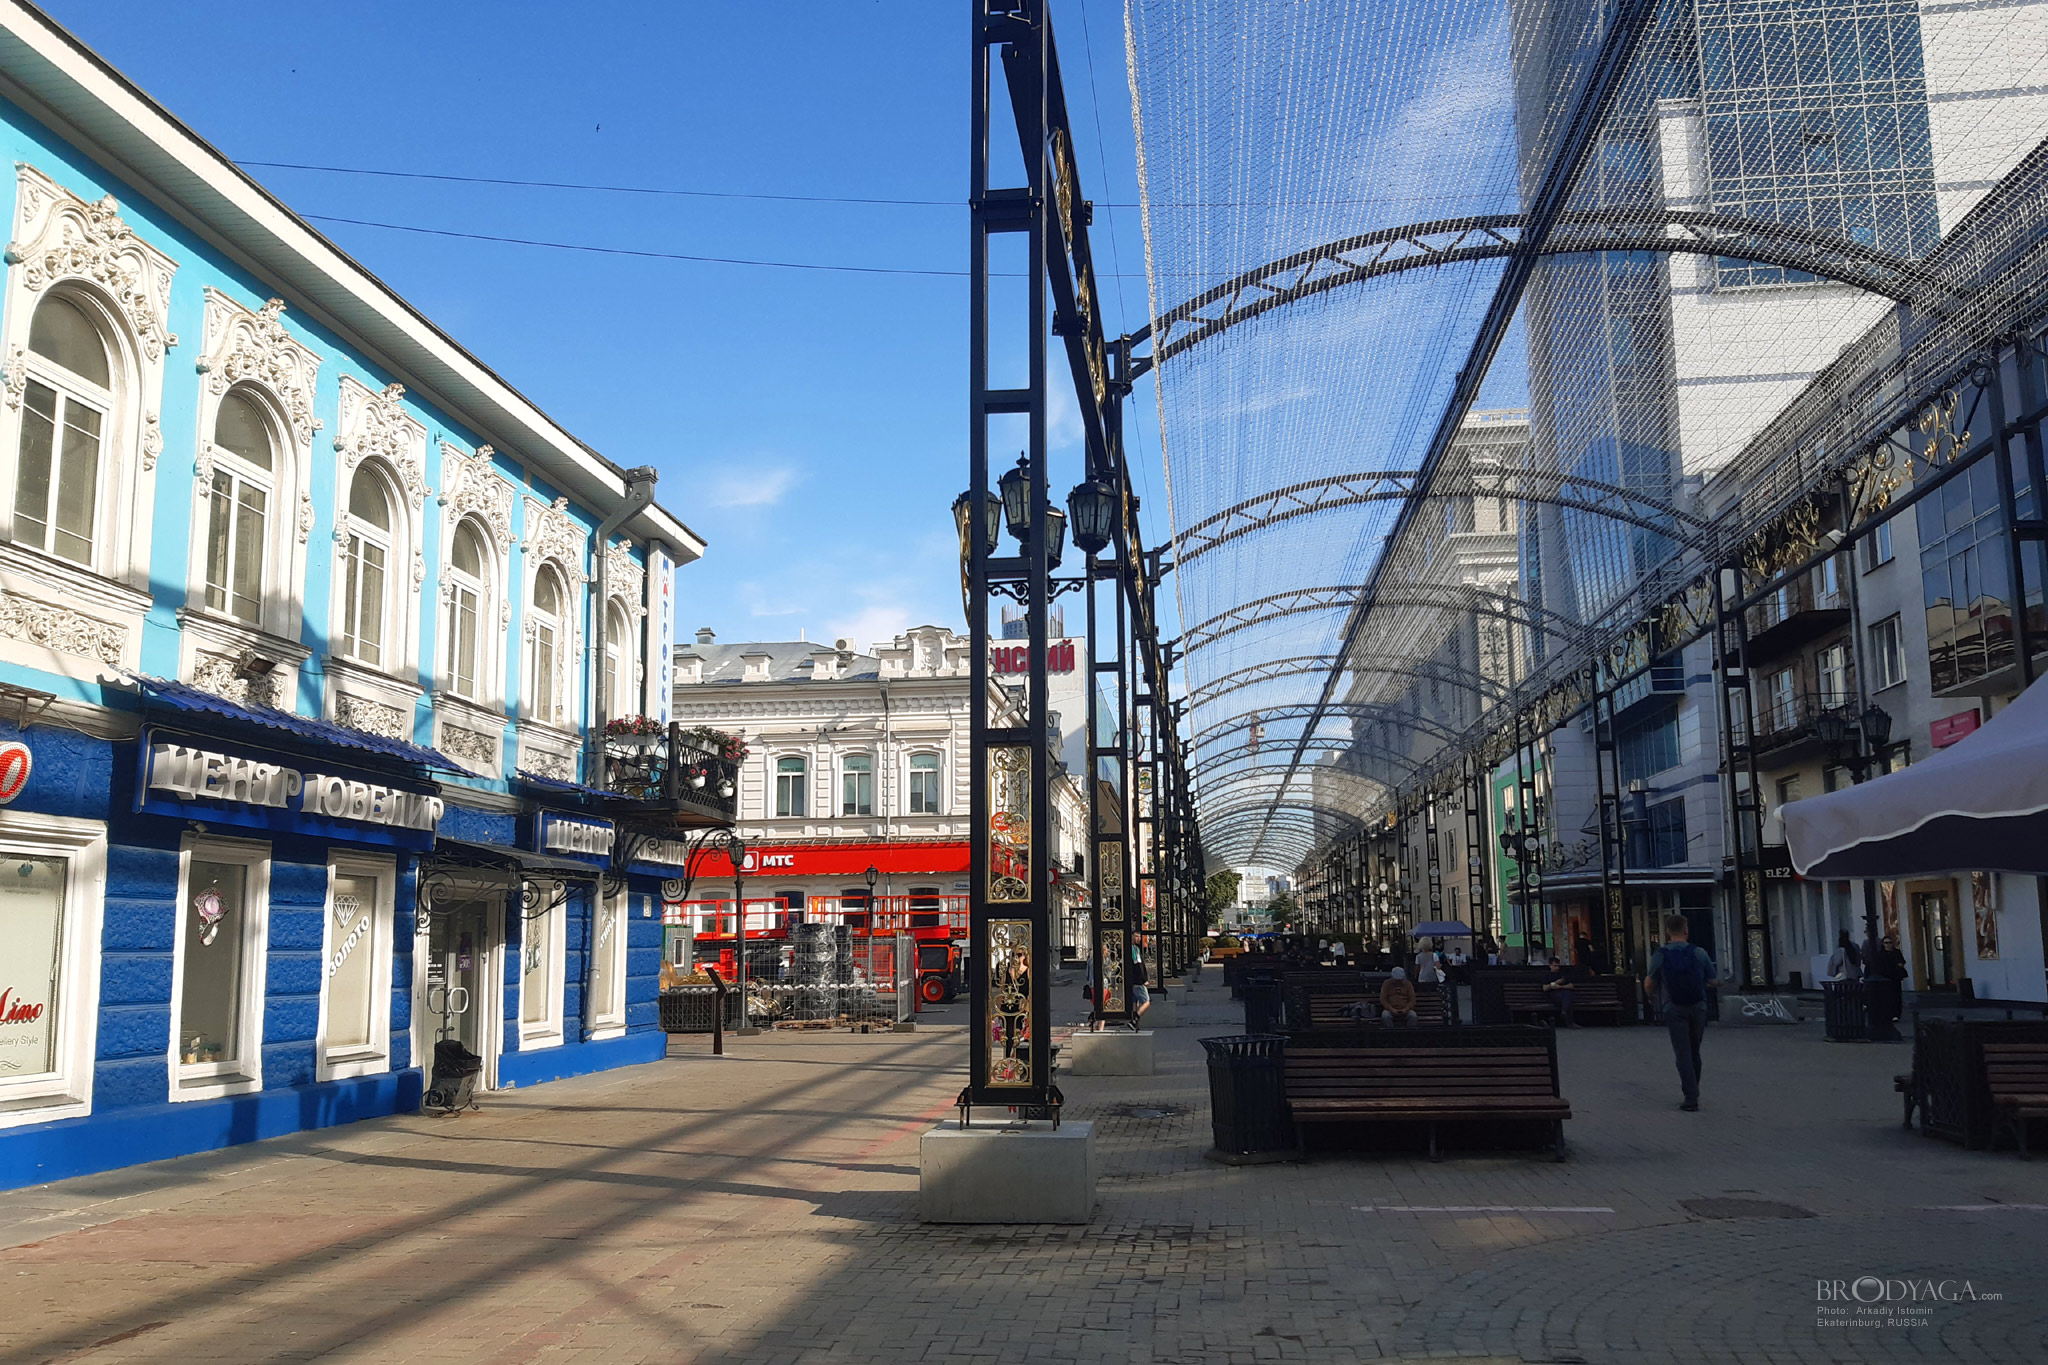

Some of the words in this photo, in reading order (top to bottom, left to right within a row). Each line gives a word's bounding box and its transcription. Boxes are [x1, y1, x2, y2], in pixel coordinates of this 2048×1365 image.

[989, 638, 1075, 674] НСИЙ
[150, 743, 302, 809] ЦЕНТР
[302, 773, 444, 832] ЮВЕЛИР
[546, 819, 616, 856] ЦЕНТР
[762, 854, 794, 867] МТС
[20, 1035, 39, 1047] Style
